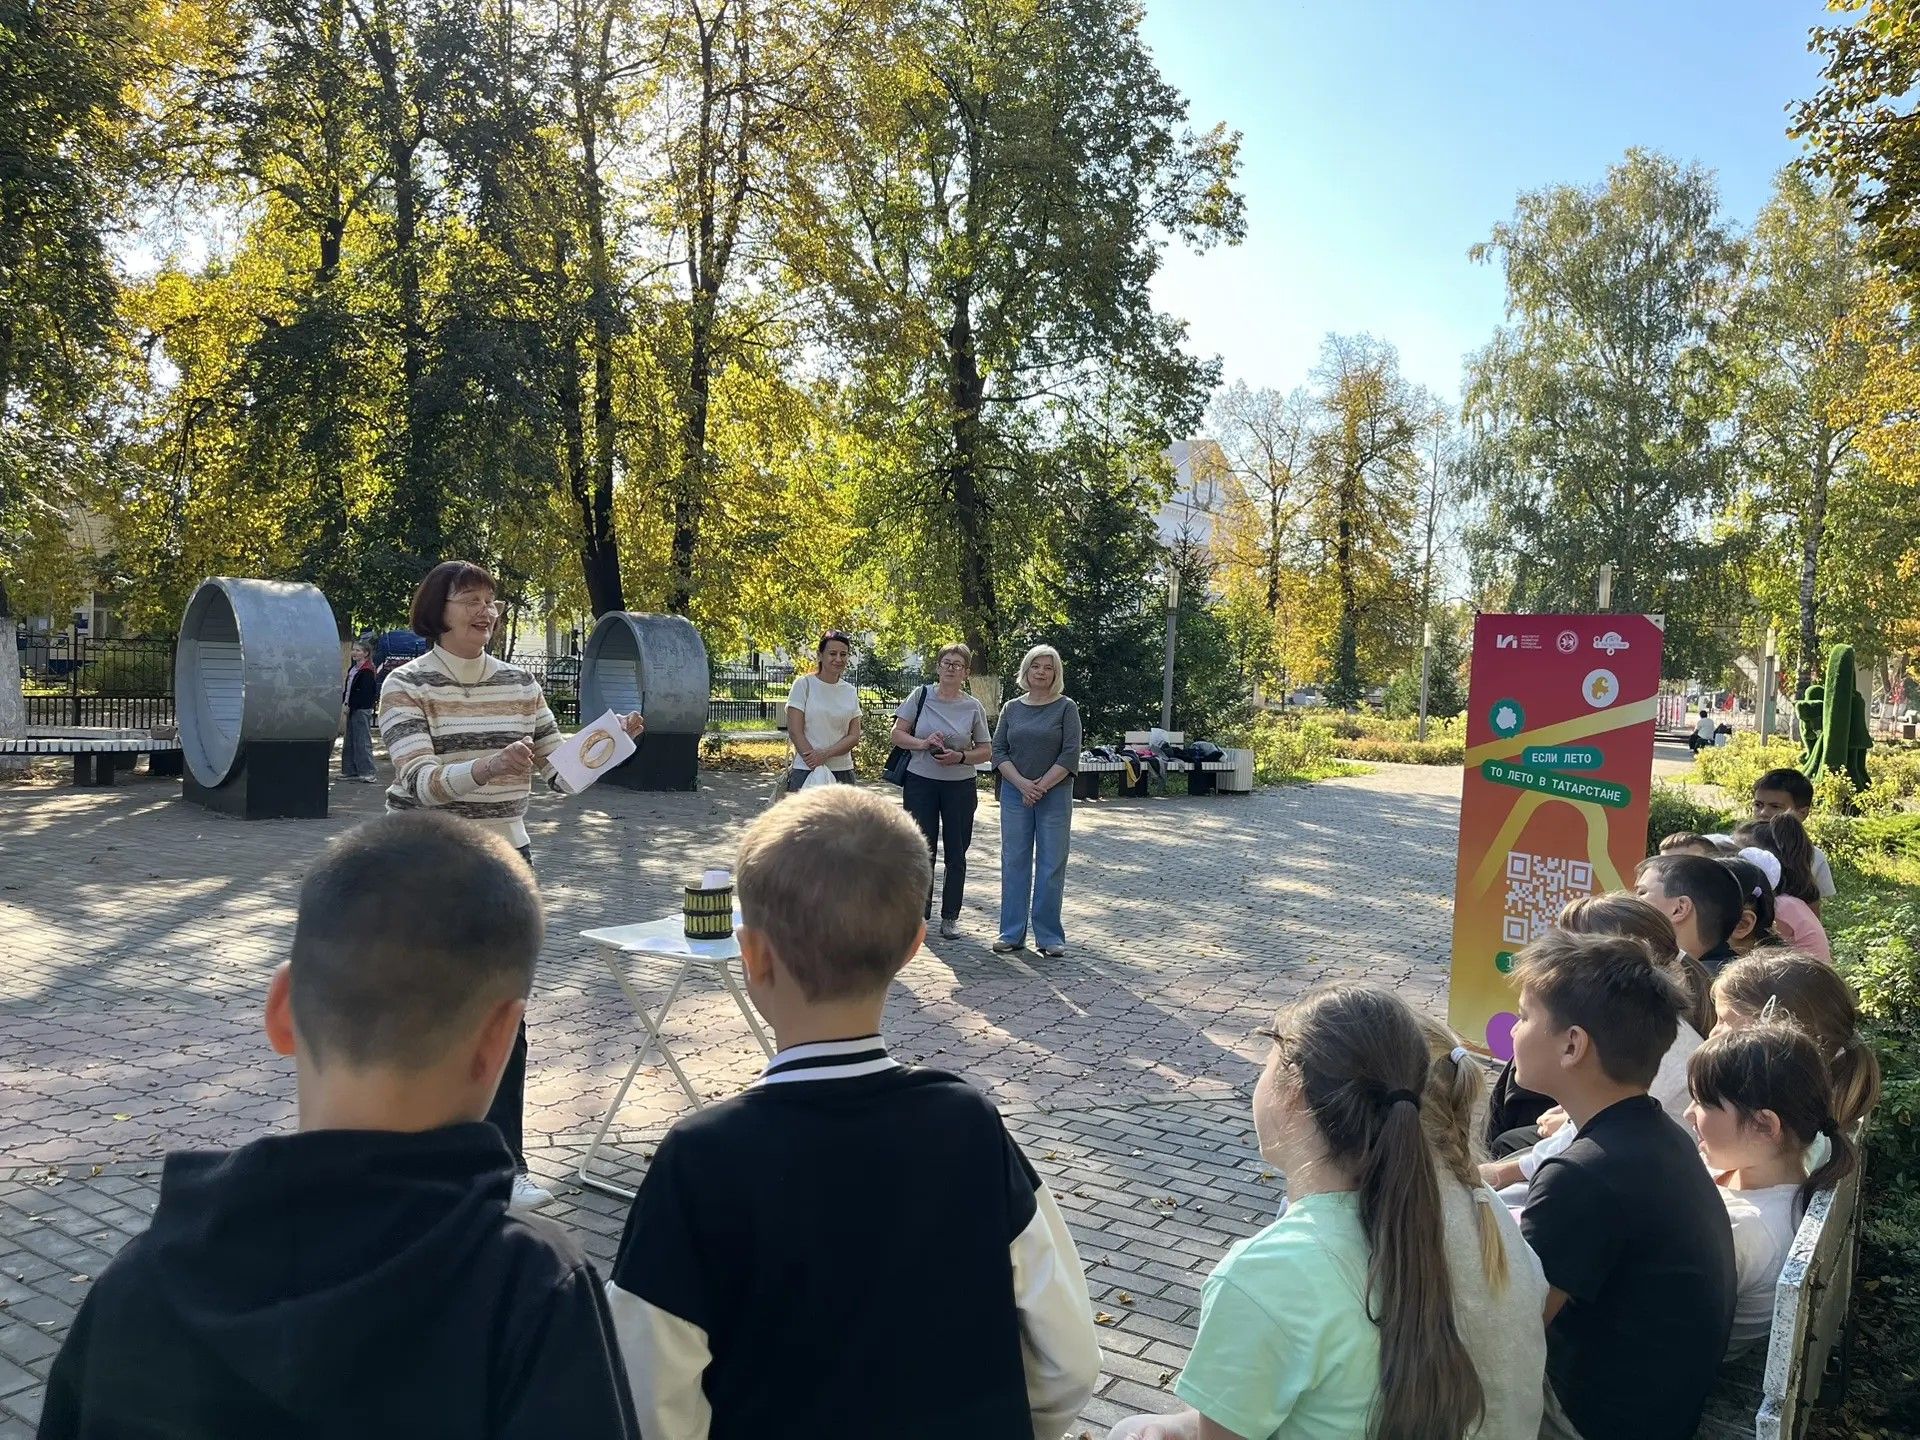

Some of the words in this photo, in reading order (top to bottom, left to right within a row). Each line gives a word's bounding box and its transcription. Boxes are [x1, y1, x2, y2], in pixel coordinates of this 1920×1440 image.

[1532, 753, 1557, 763] ЕСЛИ
[1564, 753, 1592, 764] ЛЕТО
[1490, 766, 1503, 777] ТО
[1507, 770, 1534, 784] ЛЕТО
[1539, 777, 1546, 787] В
[1552, 779, 1621, 802] ТАТАРСТАНЕ
